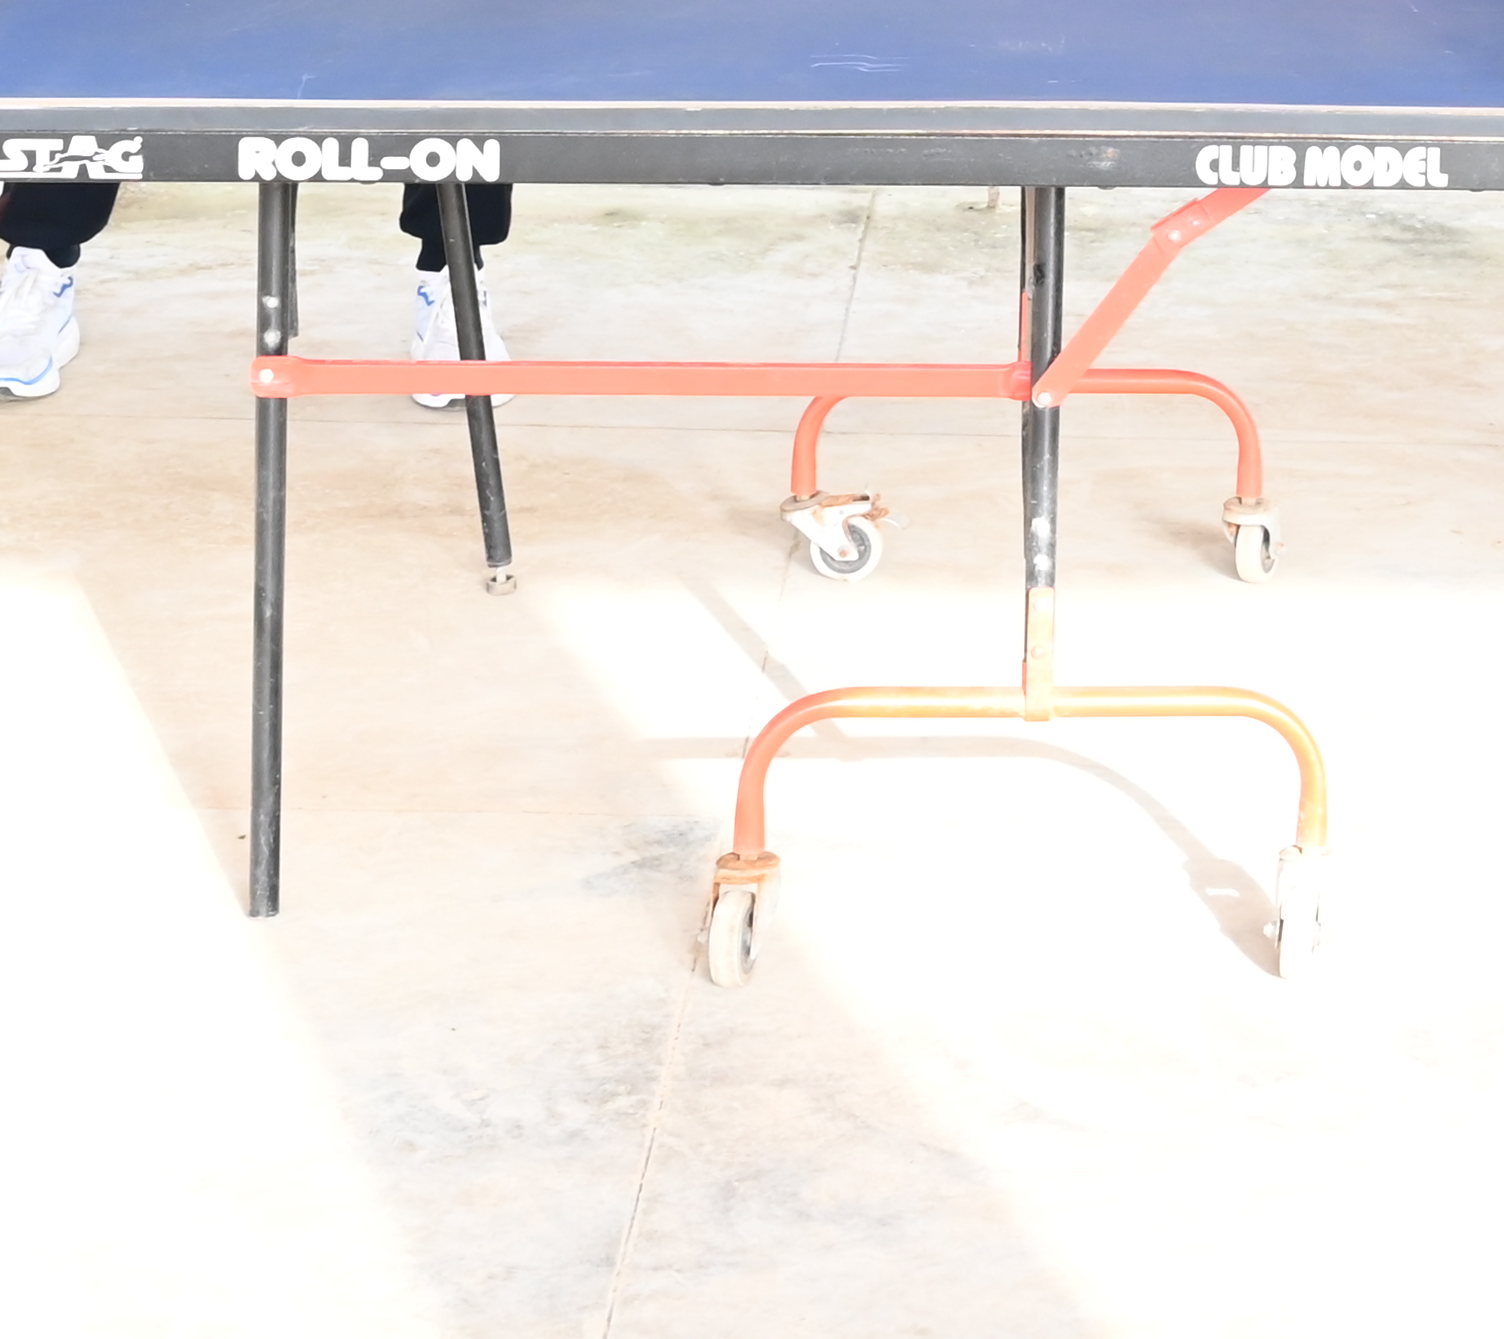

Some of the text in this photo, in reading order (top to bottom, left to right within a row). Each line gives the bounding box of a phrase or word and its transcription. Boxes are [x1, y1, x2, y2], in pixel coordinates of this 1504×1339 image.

[238, 136, 500, 181] ROLL-ON
[1195, 144, 1449, 188] CLUB MODEL
